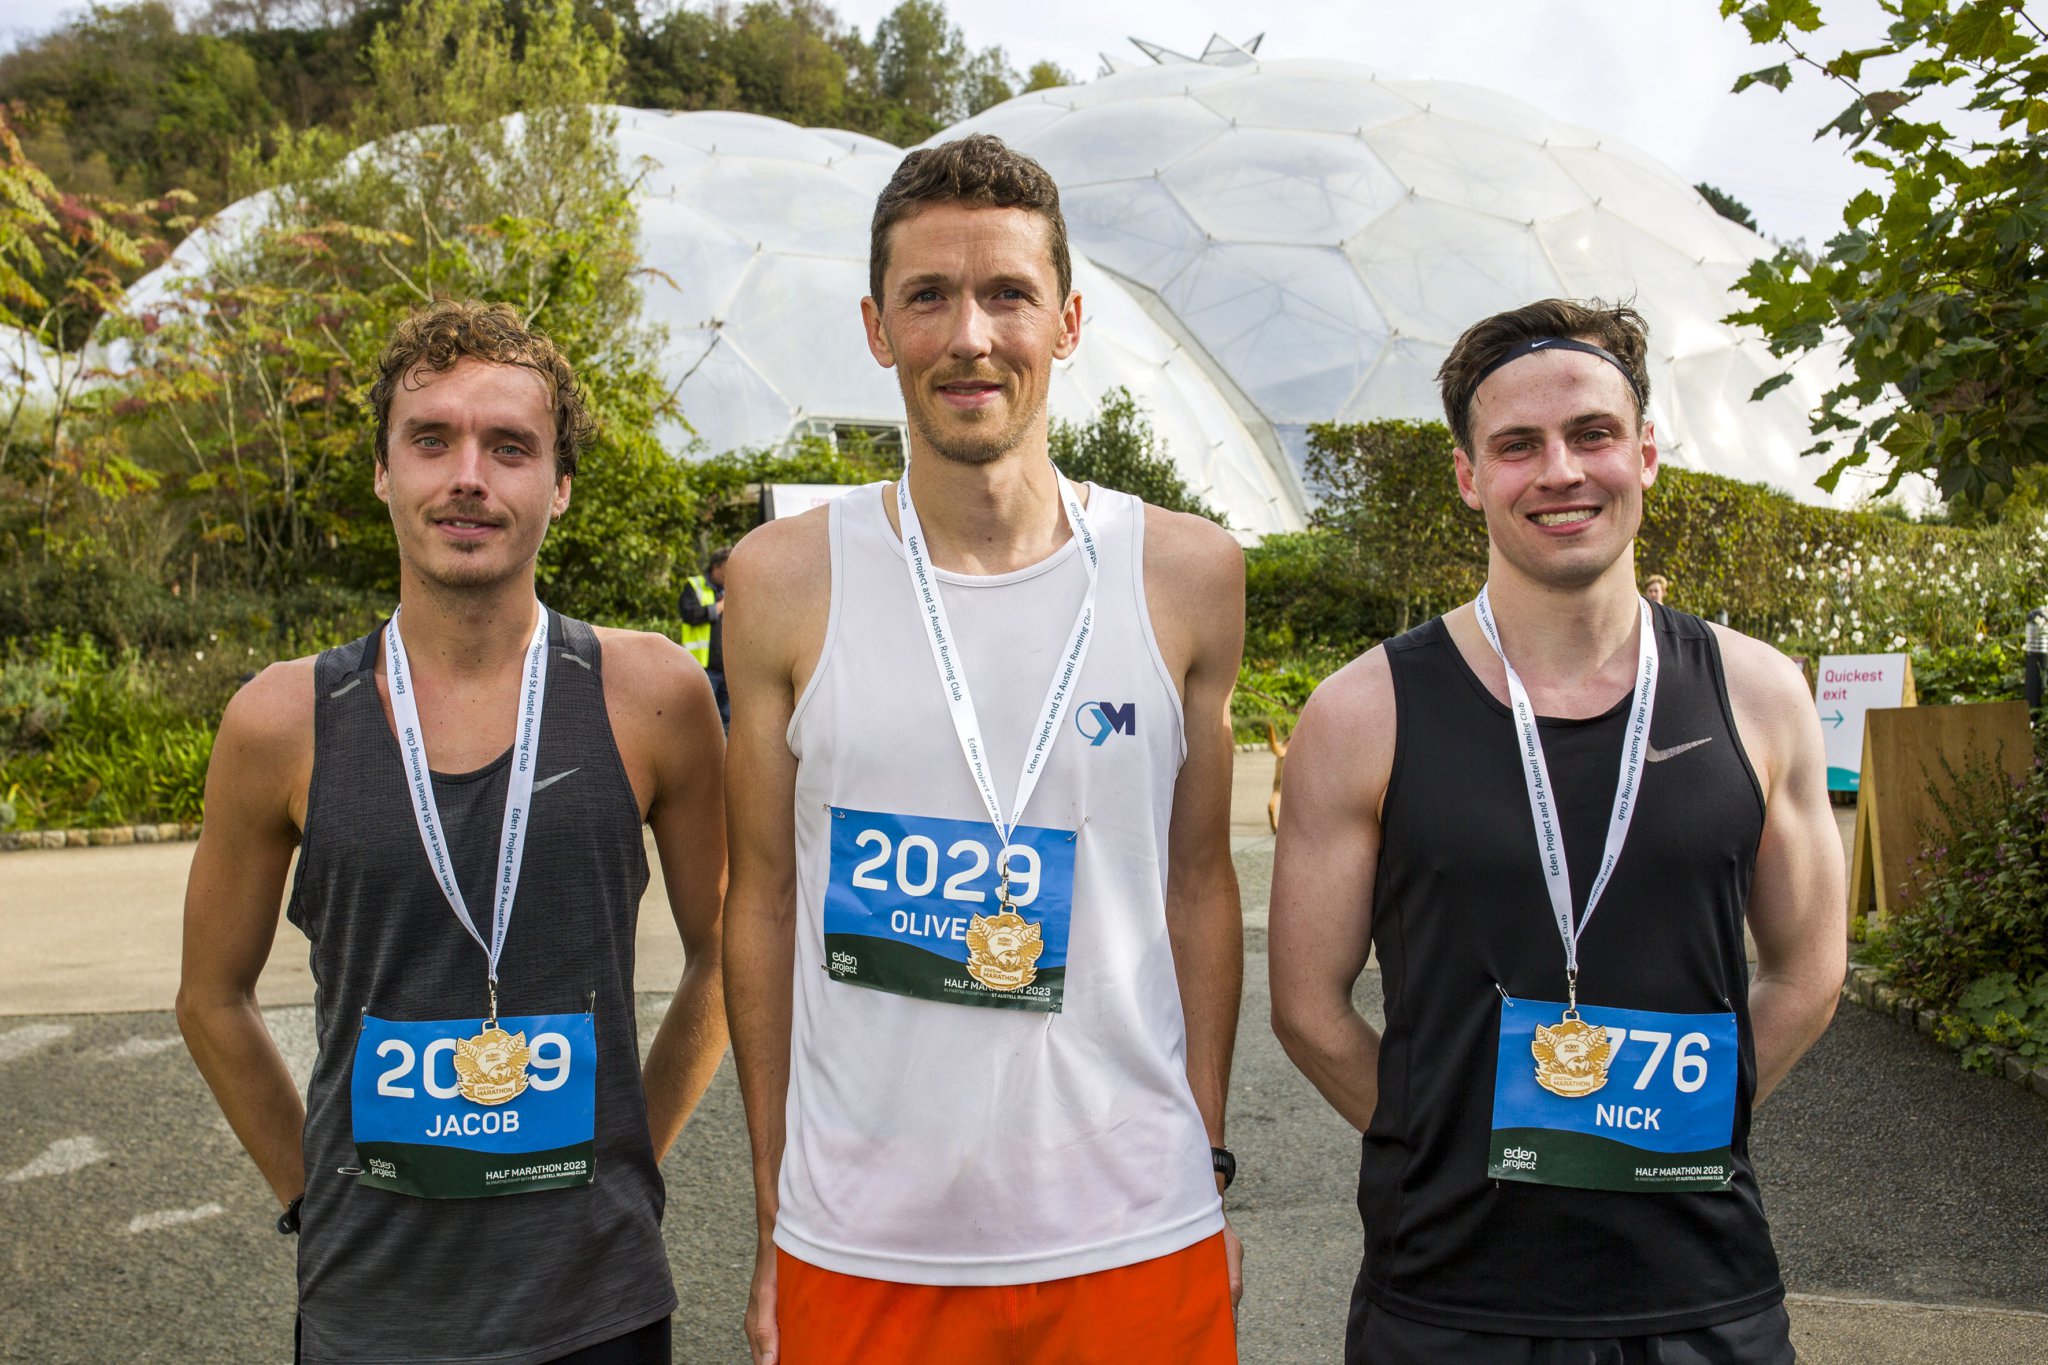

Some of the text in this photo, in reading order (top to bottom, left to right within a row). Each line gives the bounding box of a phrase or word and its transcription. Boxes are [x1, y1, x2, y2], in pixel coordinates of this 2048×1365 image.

[1070, 502, 1080, 517] Club
[909, 536, 962, 701] Eden Project and St Austell Running Club
[531, 643, 543, 664] Project
[393, 653, 402, 675] Project
[530, 665, 538, 678] and
[396, 676, 405, 695] Eden
[530, 680, 538, 688] St
[1825, 669, 1883, 683] Quickest
[1027, 607, 1092, 774] Eden Project and St Austell Running Club
[1823, 688, 1848, 700] exit
[525, 689, 537, 717] Austell
[520, 717, 533, 751] Running
[1618, 656, 1653, 821] Eden Project and St Austell Running Club
[519, 752, 529, 772] Club
[968, 737, 978, 760] Eden
[976, 762, 990, 792] Project
[1518, 702, 1560, 877] Eden Project and St Austell Running Club
[405, 727, 454, 896] Eden Project and St Austell Running Club
[510, 807, 521, 830] Eden
[505, 831, 518, 864] Project
[503, 865, 512, 883] and
[852, 829, 1042, 907] 2029
[1603, 854, 1614, 877] Eden
[502, 885, 510, 895] St
[498, 896, 508, 928] Austell
[891, 910, 972, 941] OLIVE
[831, 961, 857, 974] project
[832, 951, 857, 966] eden
[983, 972, 1019, 981] MARATHON
[944, 978, 969, 989] HALF
[1025, 986, 1051, 996] 2023
[376, 1032, 572, 1099] 209
[477, 1087, 513, 1097] MARATHON
[425, 1111, 520, 1138] JACOB
[1595, 1104, 1662, 1131] NICK
[369, 1158, 396, 1171] eden
[1502, 1158, 1536, 1170] project
[1504, 1147, 1537, 1162] eden
[372, 1166, 397, 1179] project
[485, 1160, 587, 1180] HALF MARATHON 2023
[1635, 1166, 1724, 1176] HALF MARATHON 2023
